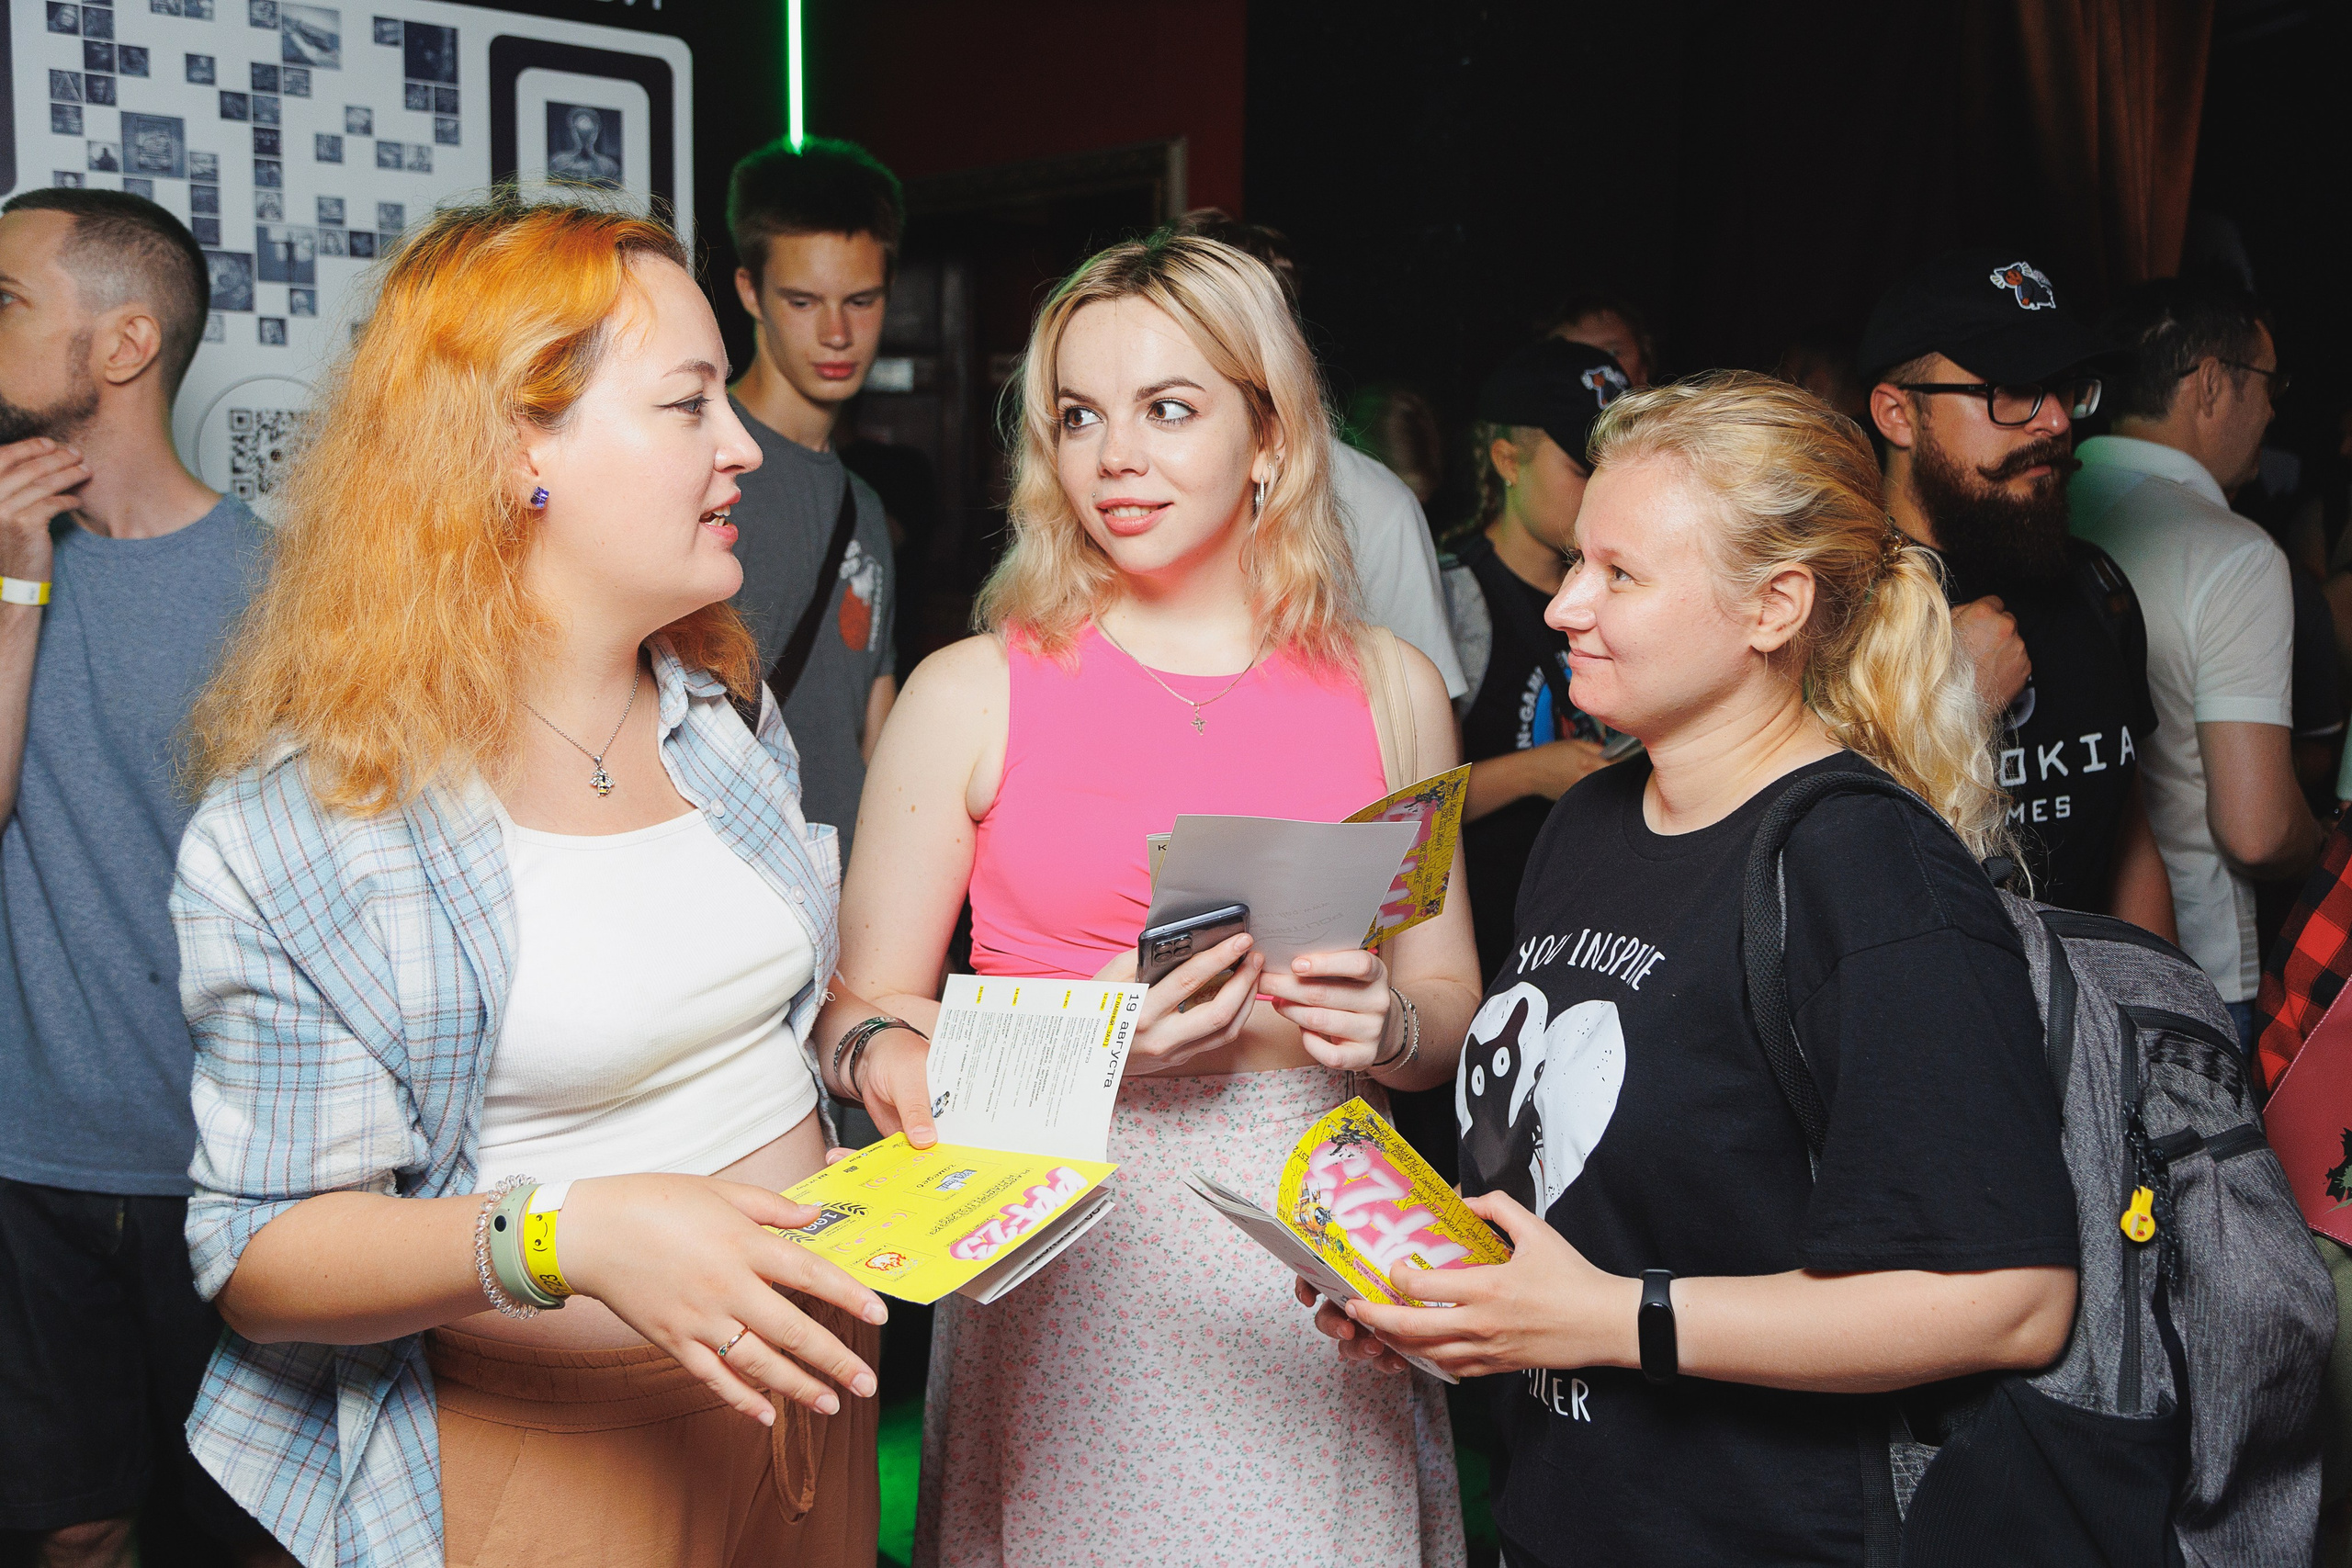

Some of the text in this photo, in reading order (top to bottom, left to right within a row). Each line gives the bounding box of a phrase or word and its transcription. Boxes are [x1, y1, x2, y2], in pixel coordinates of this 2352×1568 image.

[1999, 726, 2136, 787] OKIA
[2005, 795, 2071, 826] MES
[1517, 932, 1573, 975] YOU
[1125, 993, 1140, 1012] 19
[1102, 1021, 1130, 1089] августа
[1340, 1101, 1385, 1144] PLAYPORT FEST
[1390, 1139, 1421, 1168] PLAYPORT
[1390, 1147, 1448, 1202] PLAYPORT FEST 2023
[1409, 1187, 1466, 1240] PLAYPORT FEST 2023
[1410, 1252, 1428, 1269] 2023
[1478, 1239, 1495, 1255] FEST
